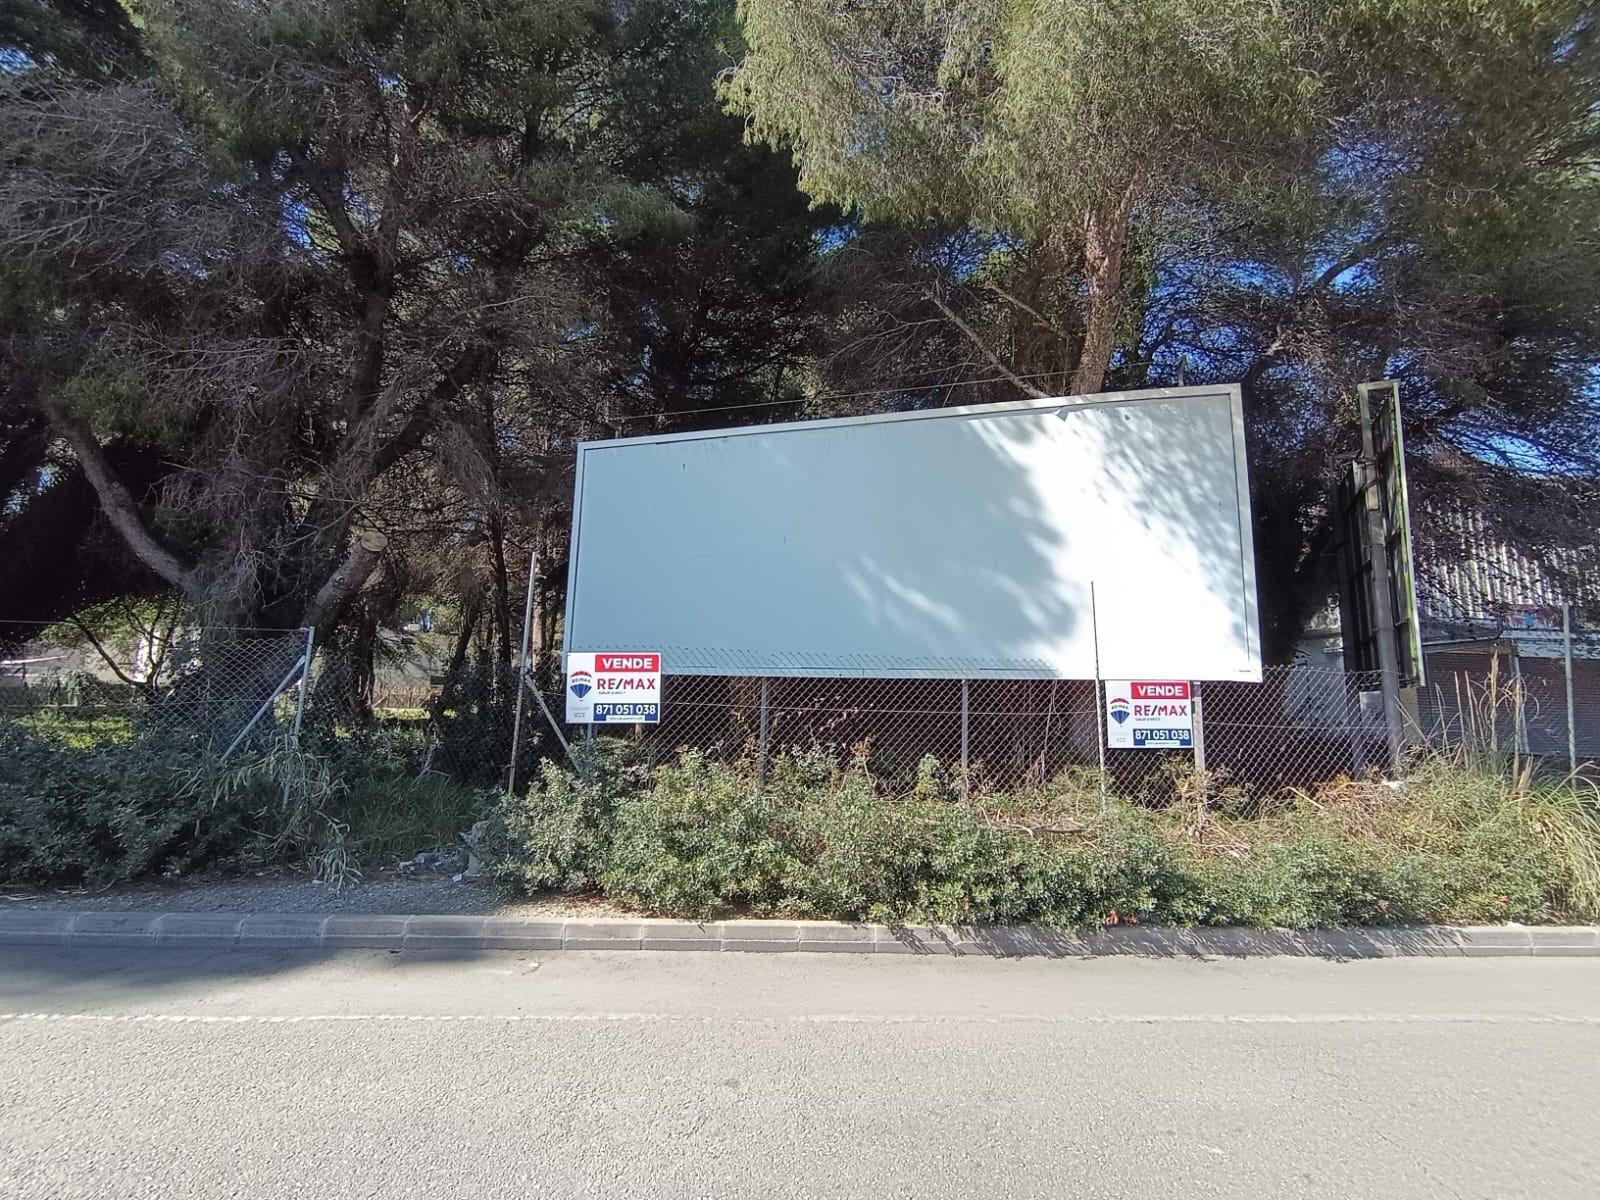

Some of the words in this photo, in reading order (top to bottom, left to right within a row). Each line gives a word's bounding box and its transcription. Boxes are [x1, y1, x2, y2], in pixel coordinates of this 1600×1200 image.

[602, 658, 653, 669] VENDE
[597, 678, 656, 690] RE/MAX
[1137, 685, 1184, 697] VENDE
[595, 704, 613, 715] 871
[615, 704, 633, 715] 051
[636, 704, 656, 715] 038
[1134, 704, 1187, 716] RE/MAX
[1135, 729, 1151, 740] 871
[1152, 729, 1169, 740] 051
[1171, 729, 1189, 740] 038
